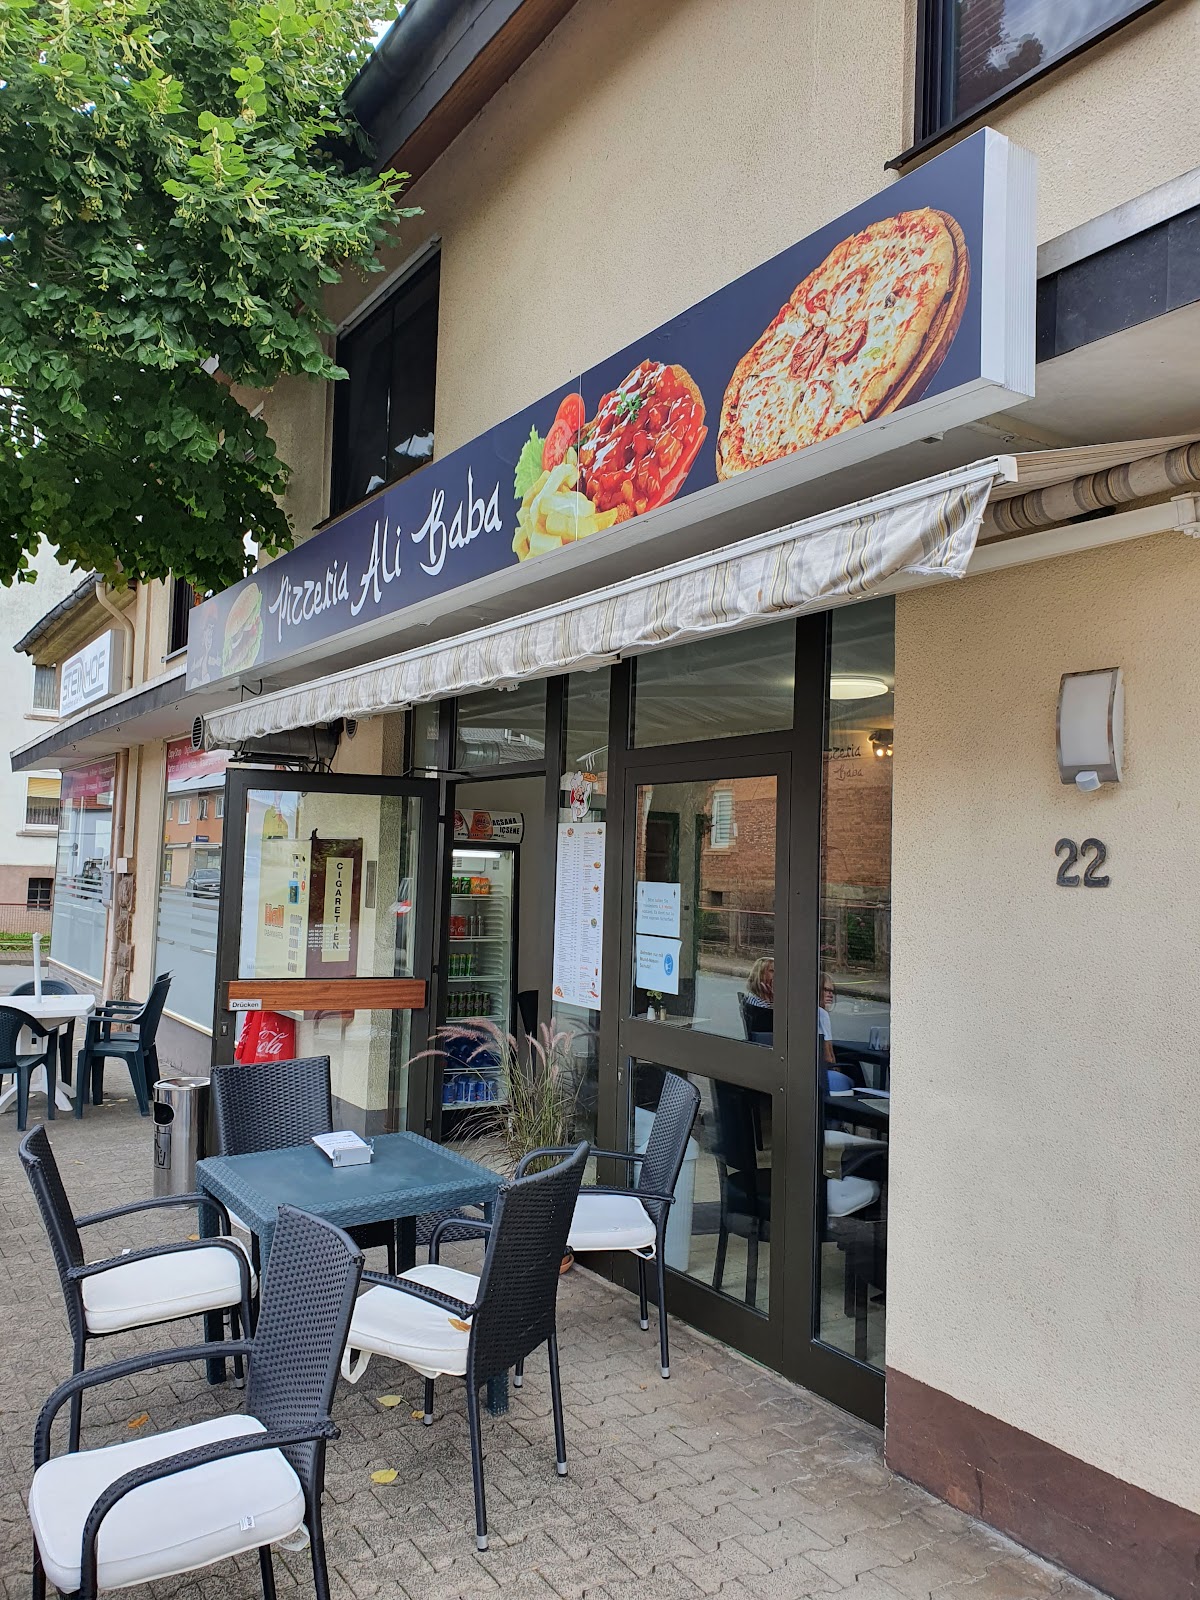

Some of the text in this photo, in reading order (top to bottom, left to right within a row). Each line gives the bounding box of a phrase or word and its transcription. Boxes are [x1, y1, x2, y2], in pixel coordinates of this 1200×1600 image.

[269, 466, 502, 643] Pizzeria Ali Baba
[1055, 837, 1110, 888] 22
